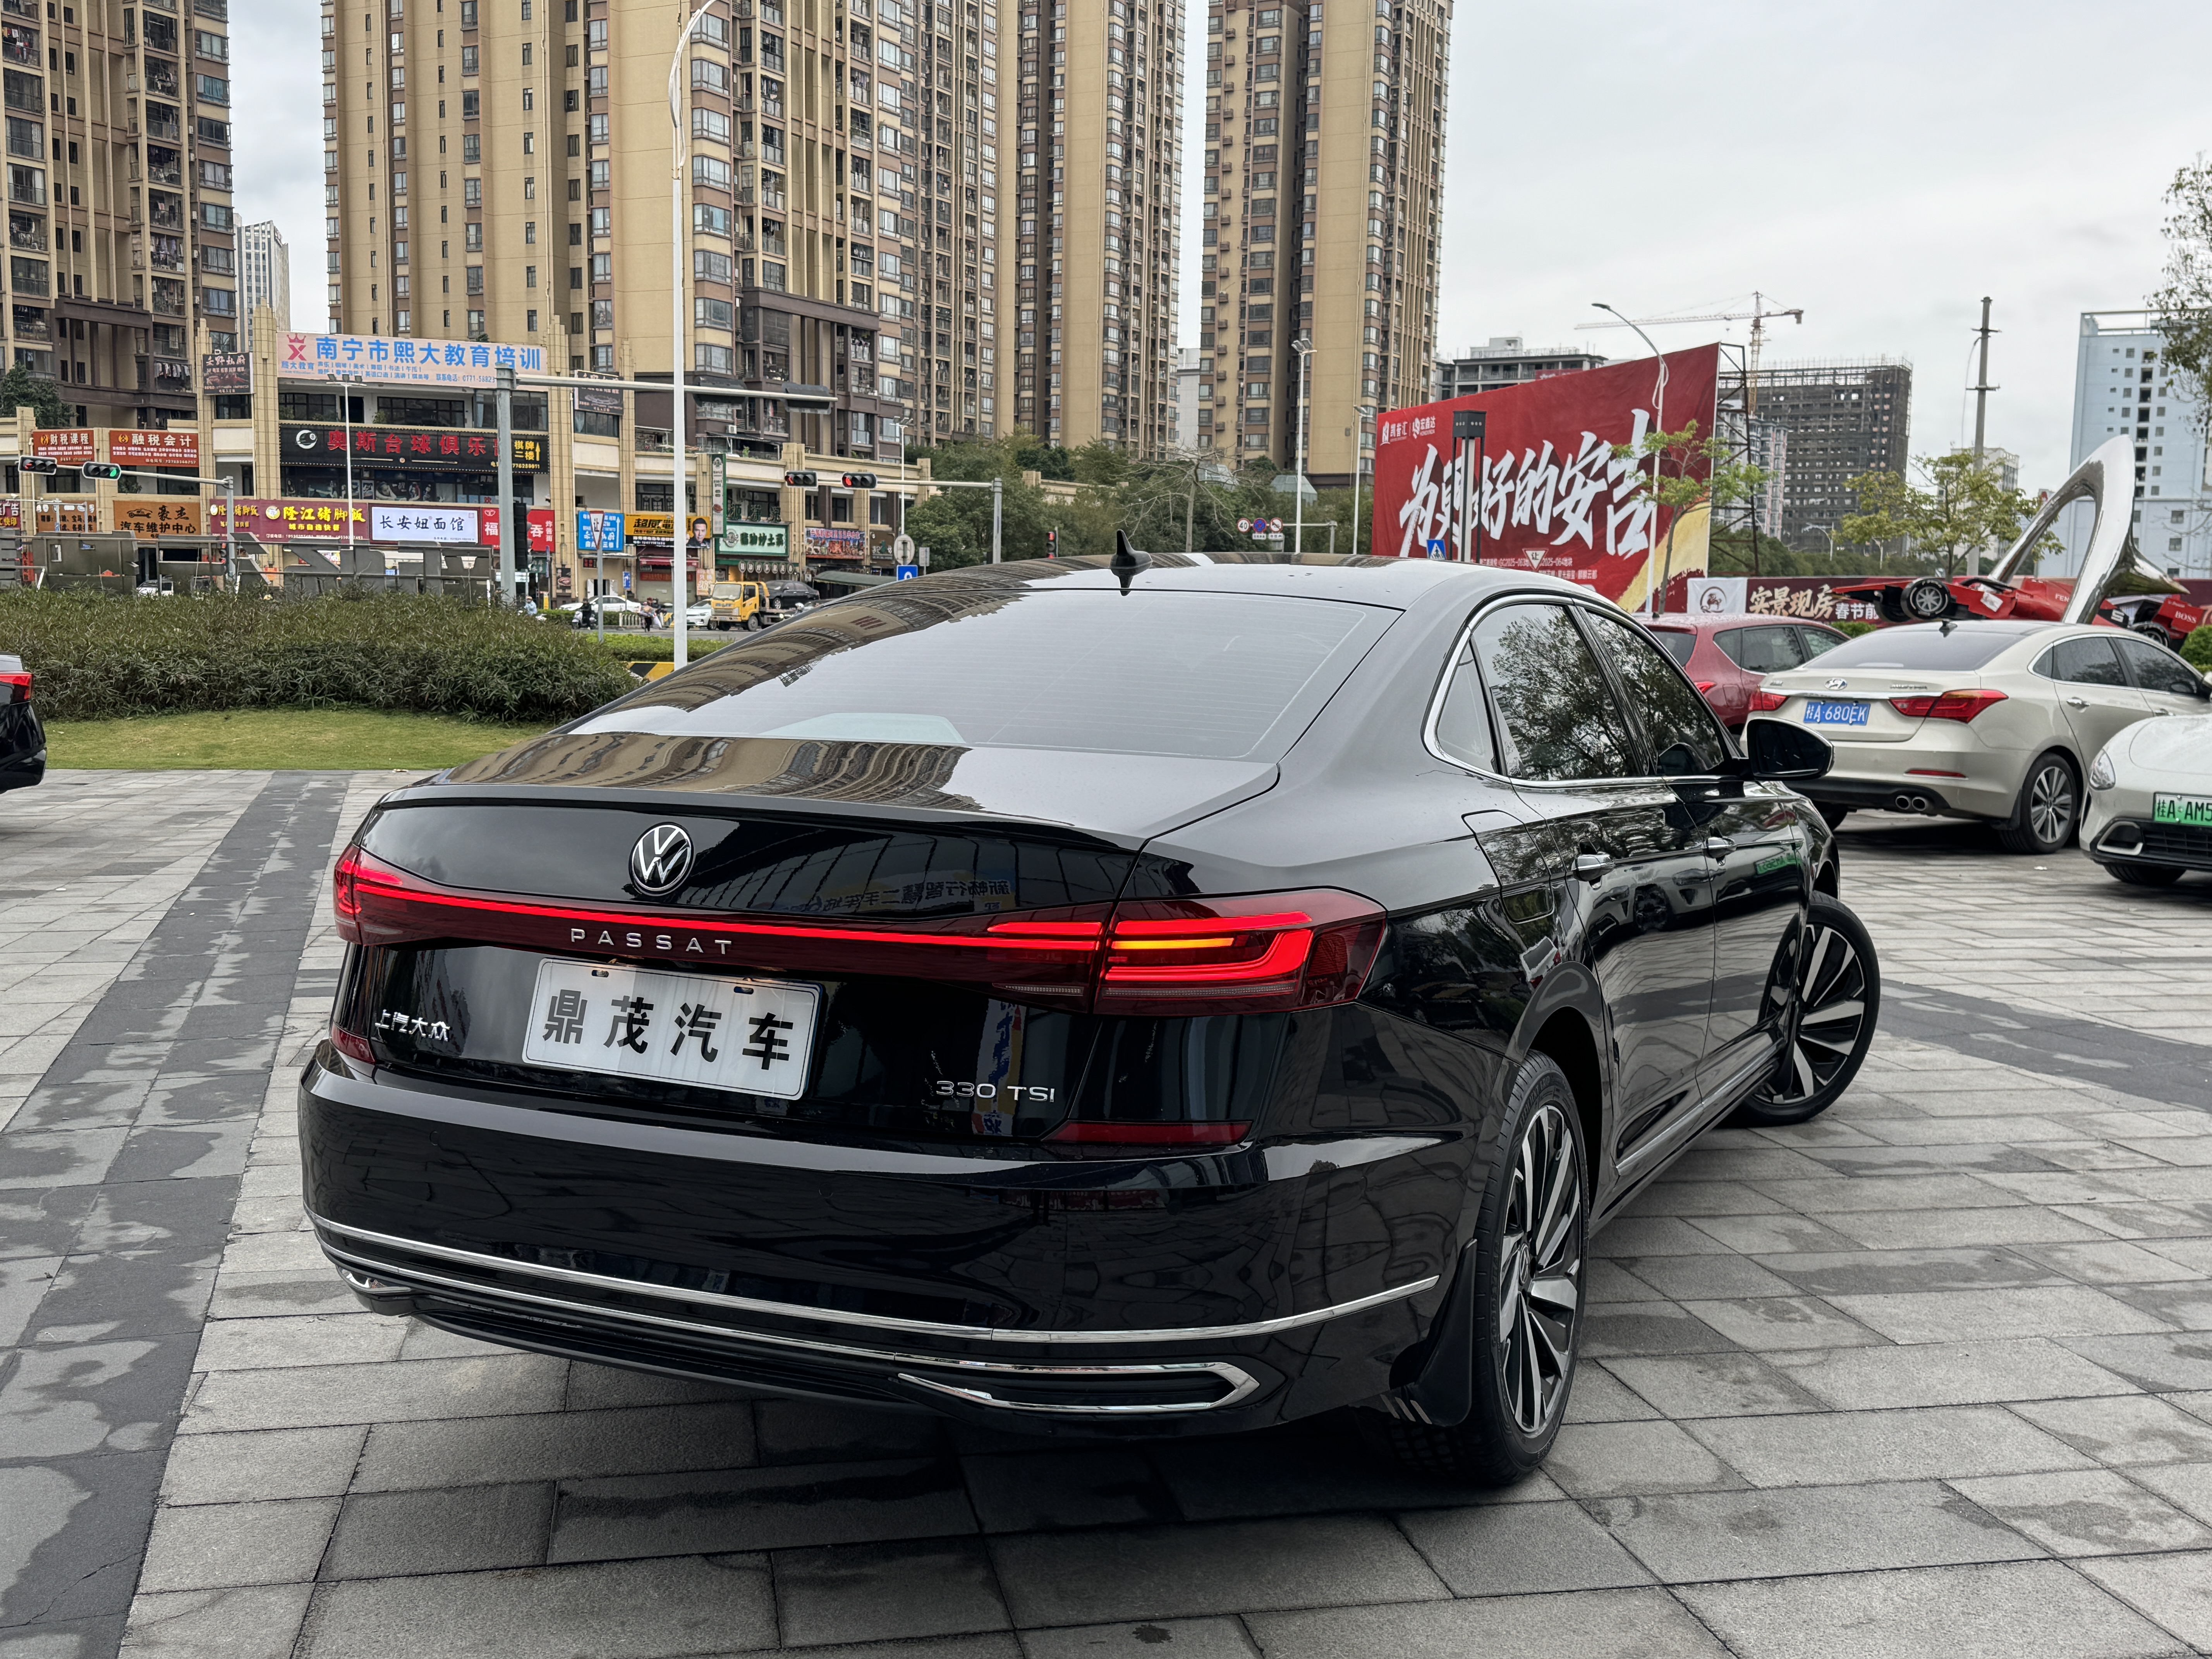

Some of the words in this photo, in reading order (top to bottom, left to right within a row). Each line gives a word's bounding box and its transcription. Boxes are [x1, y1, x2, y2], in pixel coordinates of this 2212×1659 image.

[316, 336, 541, 371] 南宁市熙大教育培训
[50, 433, 89, 445] 财税课程
[132, 433, 192, 447] 融税会计
[514, 440, 534, 450] 棋牌
[514, 451, 534, 460] 二楼
[1399, 409, 1655, 560] 为更好的安吉
[158, 505, 189, 521] 豪杰
[218, 505, 260, 517] 隆猪脚饭
[283, 506, 366, 523] 隆江猪脚饭
[120, 521, 196, 533] 汽车维护中心
[380, 515, 464, 531] 长安妞面馆
[1532, 552, 1539, 560] 让
[1749, 584, 1837, 619] 实景现房
[2175, 611, 2197, 624] BOSS
[571, 928, 732, 954] PASSAT
[375, 1009, 451, 1042] 上汽大众
[543, 989, 794, 1070] 鼎茂汽车
[936, 1080, 996, 1098] 330
[1007, 1085, 1055, 1103] TSI
